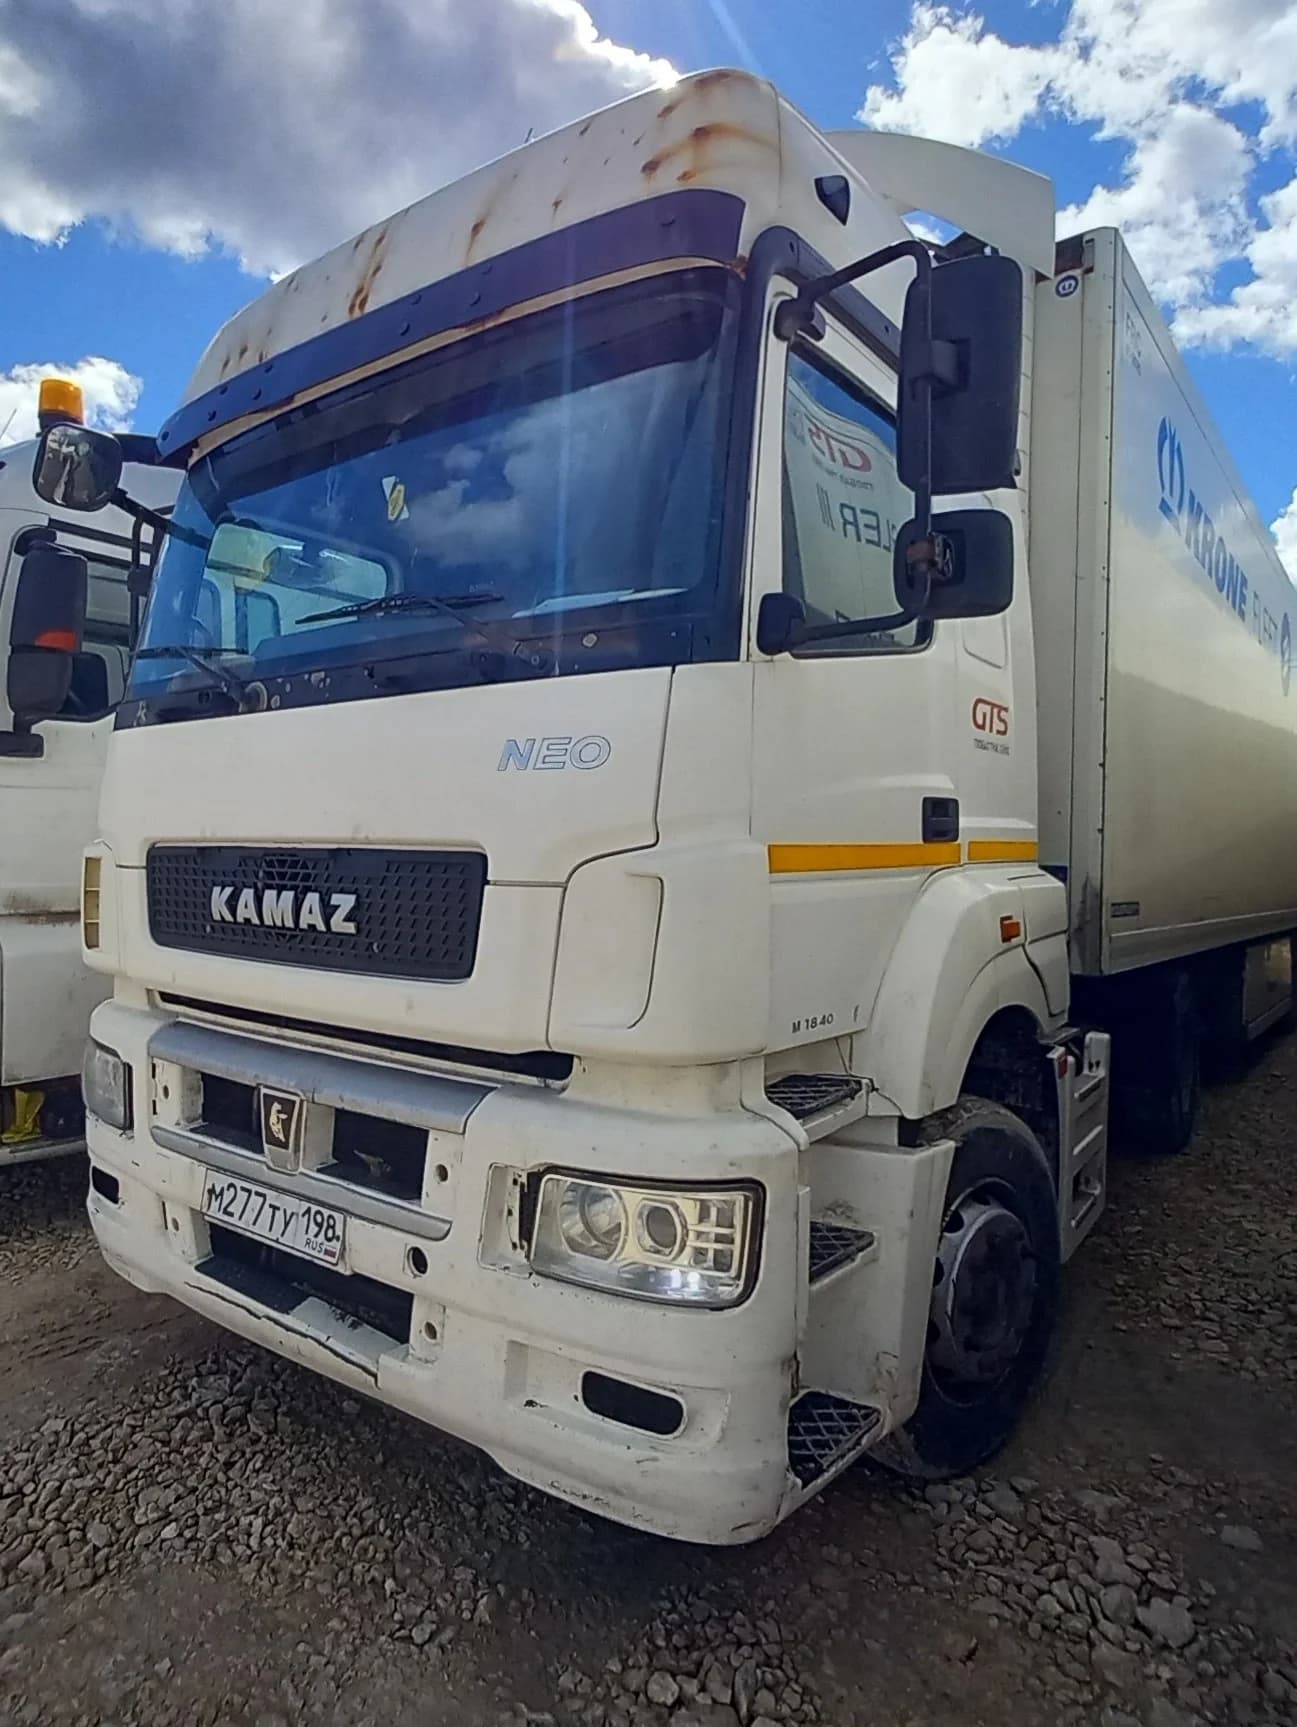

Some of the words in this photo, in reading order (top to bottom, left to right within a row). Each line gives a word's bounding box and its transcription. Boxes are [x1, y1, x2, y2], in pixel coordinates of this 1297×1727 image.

[1185, 487, 1249, 623] KRONE
[972, 697, 1009, 736] GTS
[497, 735, 611, 772] NEO
[209, 885, 359, 935] KAMAZ
[791, 1020, 801, 1034] M
[804, 1013, 834, 1031] 1840
[301, 1206, 338, 1244] 198
[304, 1238, 325, 1254] RUS
